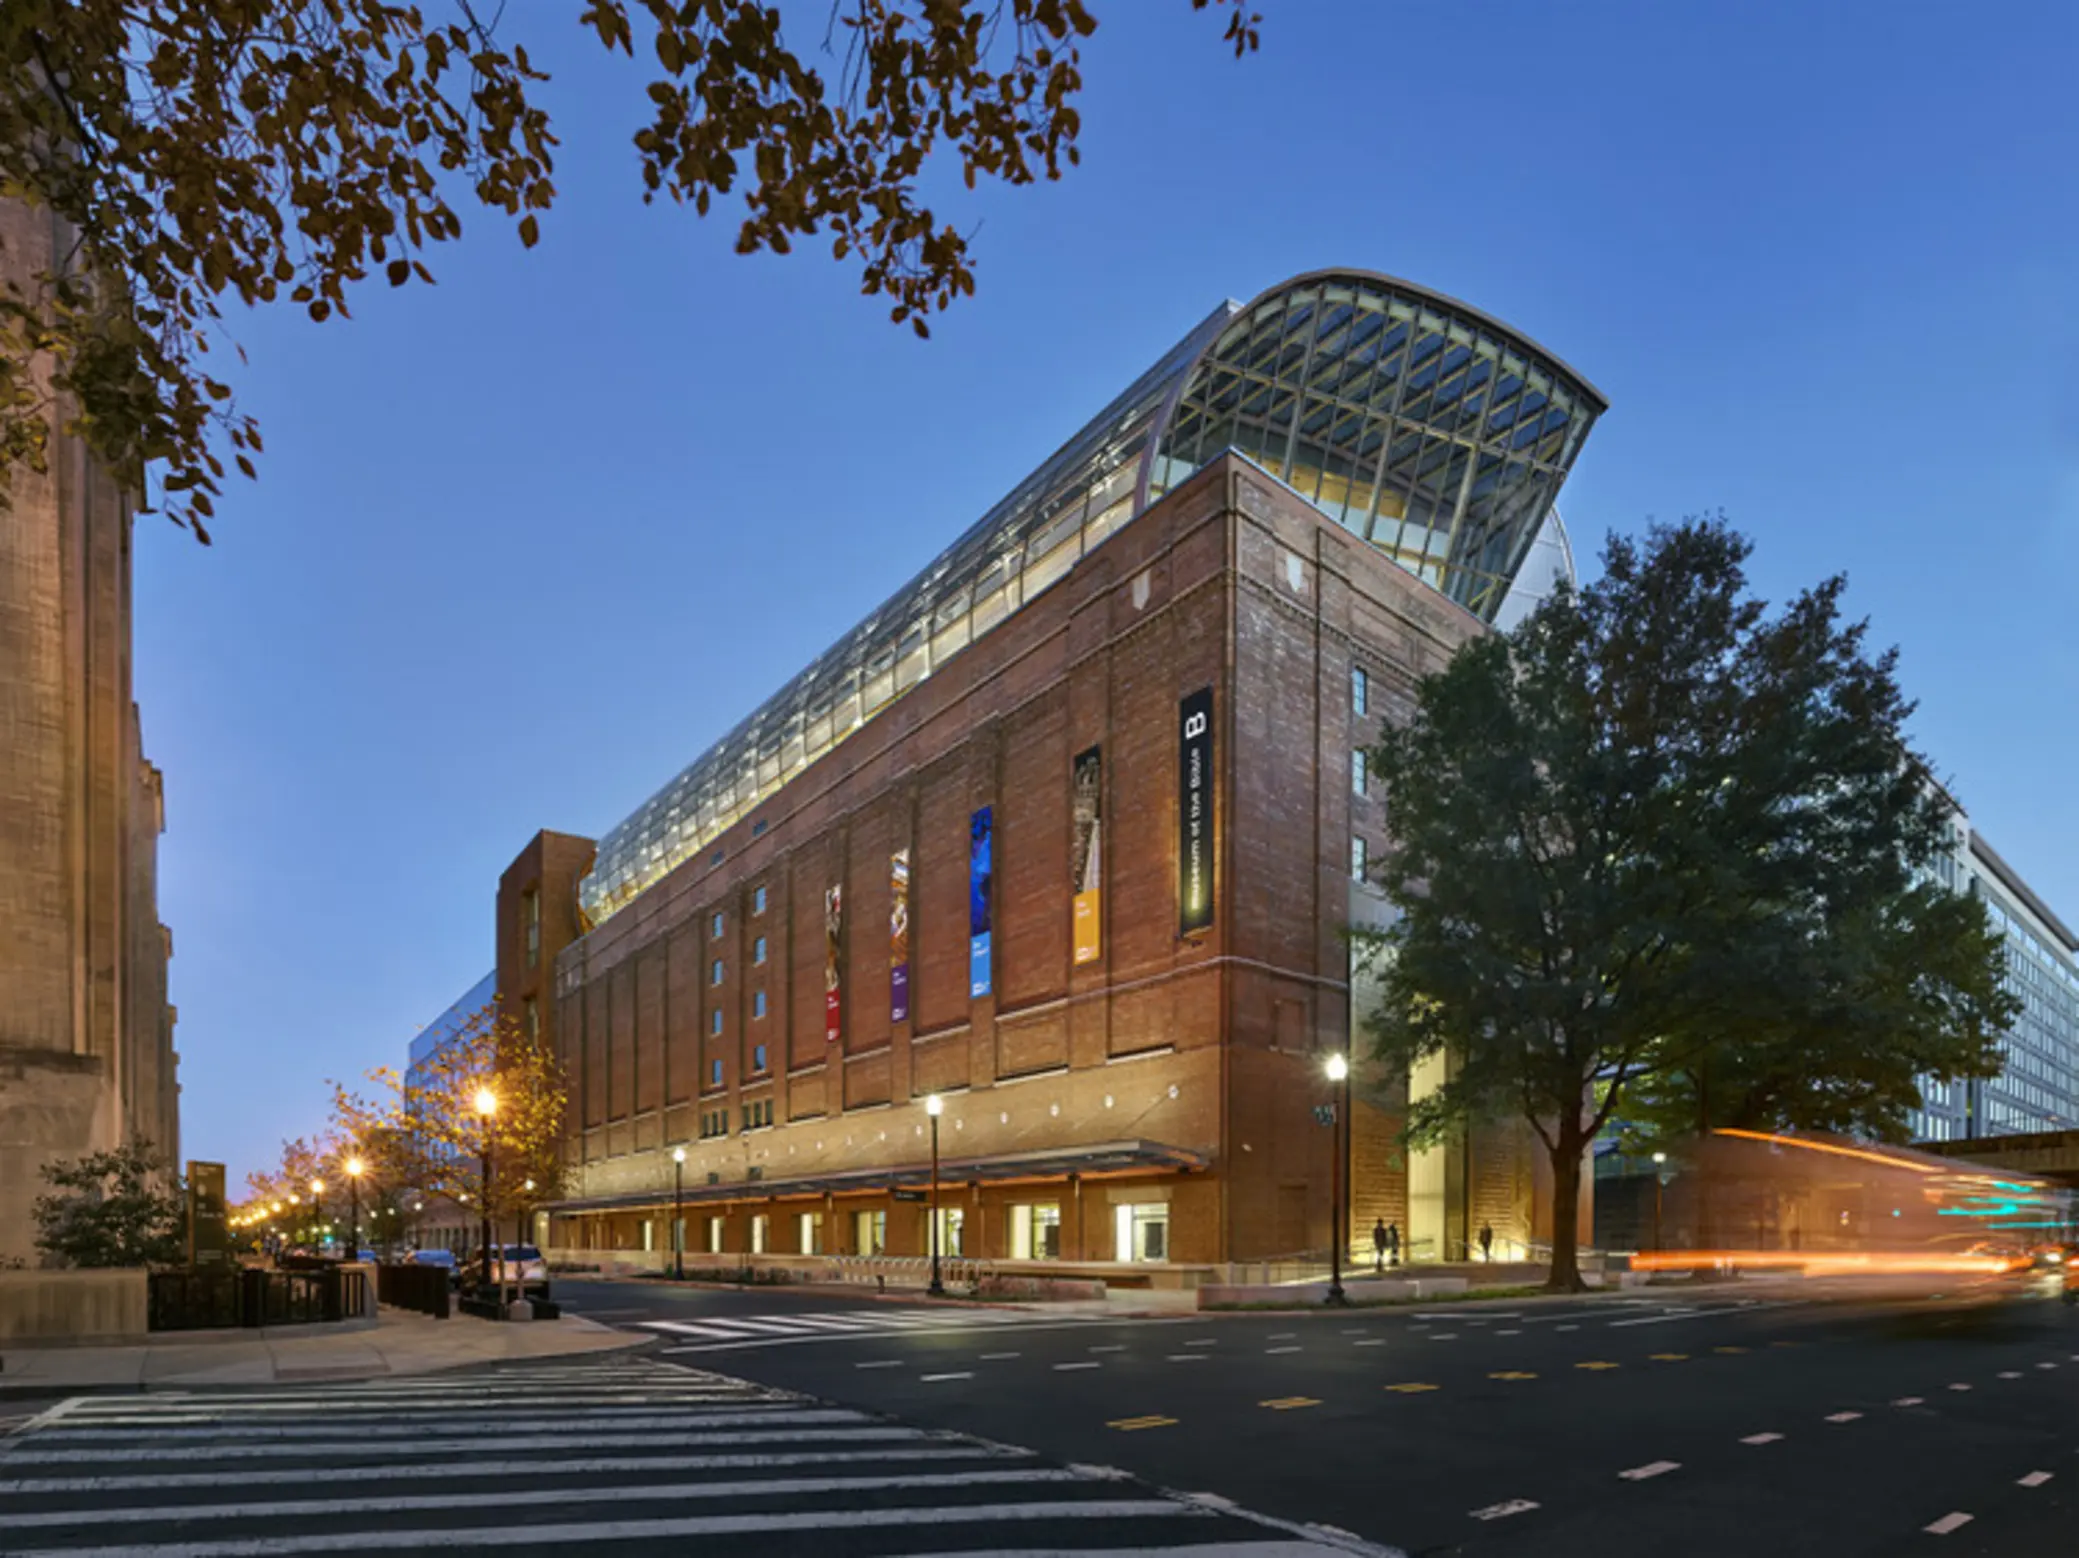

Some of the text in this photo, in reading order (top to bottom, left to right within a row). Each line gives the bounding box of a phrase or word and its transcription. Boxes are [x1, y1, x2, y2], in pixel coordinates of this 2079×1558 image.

[1185, 711, 1207, 740] B
[1189, 791, 1200, 819] the
[1189, 820, 1200, 838] of
